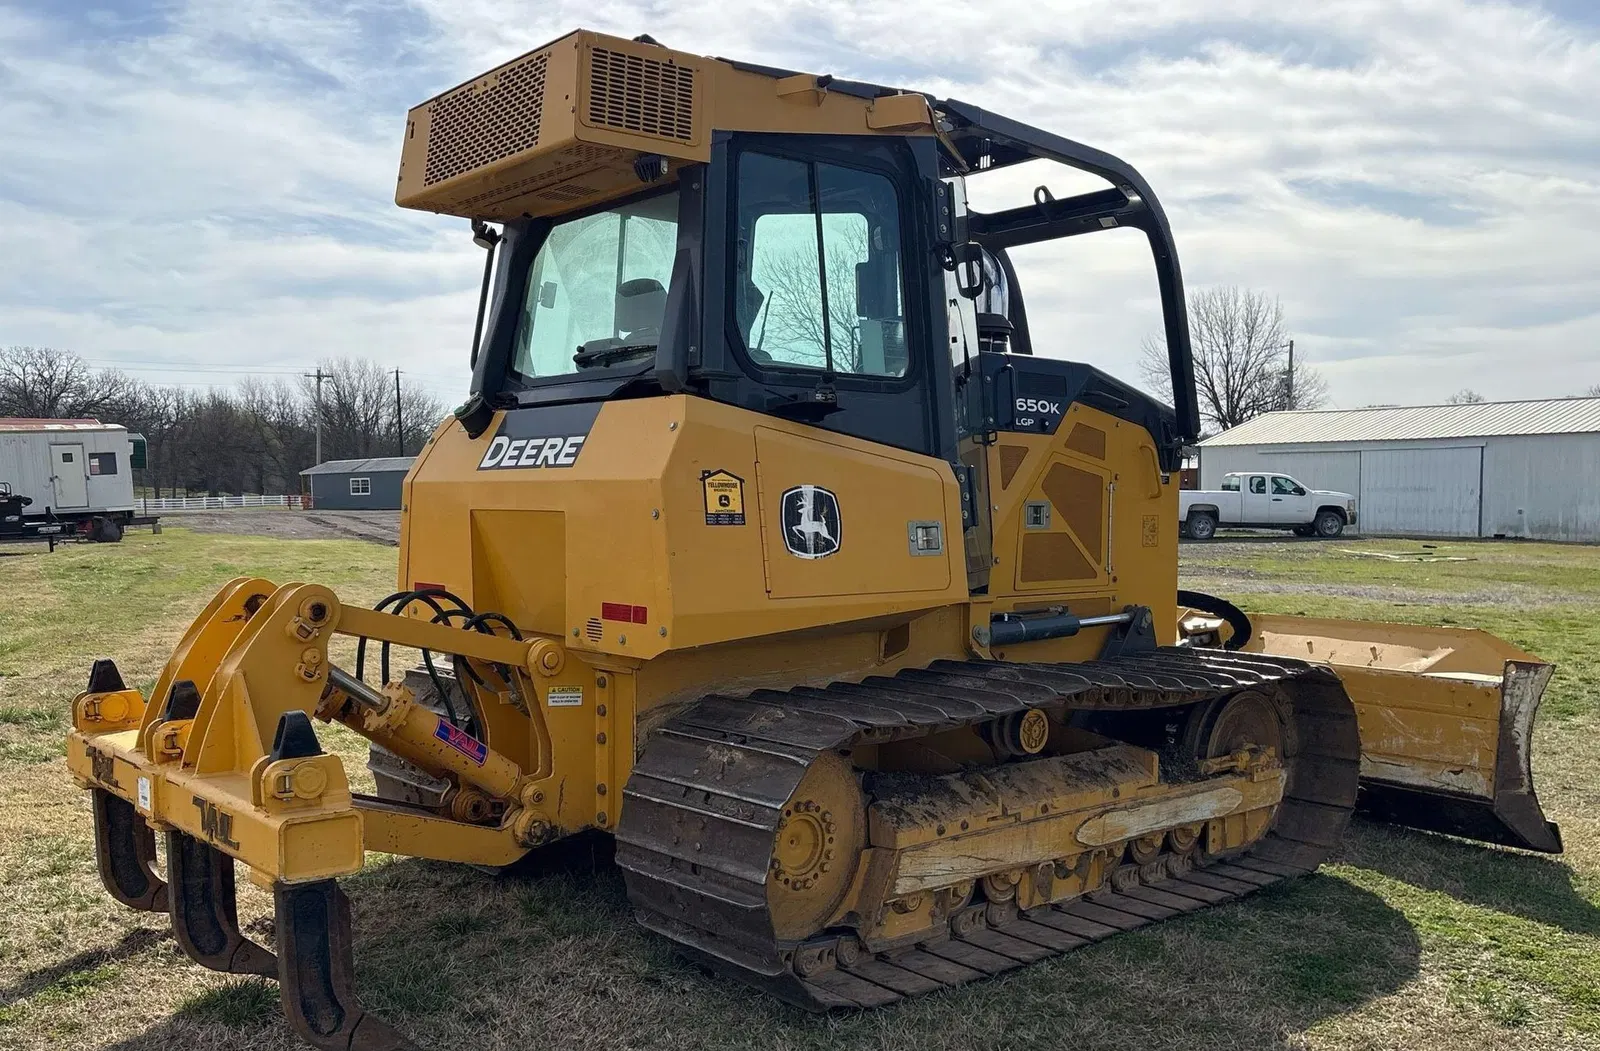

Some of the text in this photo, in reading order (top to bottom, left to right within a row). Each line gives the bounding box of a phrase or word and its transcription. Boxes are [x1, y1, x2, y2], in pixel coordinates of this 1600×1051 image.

[1016, 398, 1060, 414] 650K
[1015, 417, 1035, 426] LGP
[480, 436, 586, 468] DEERE
